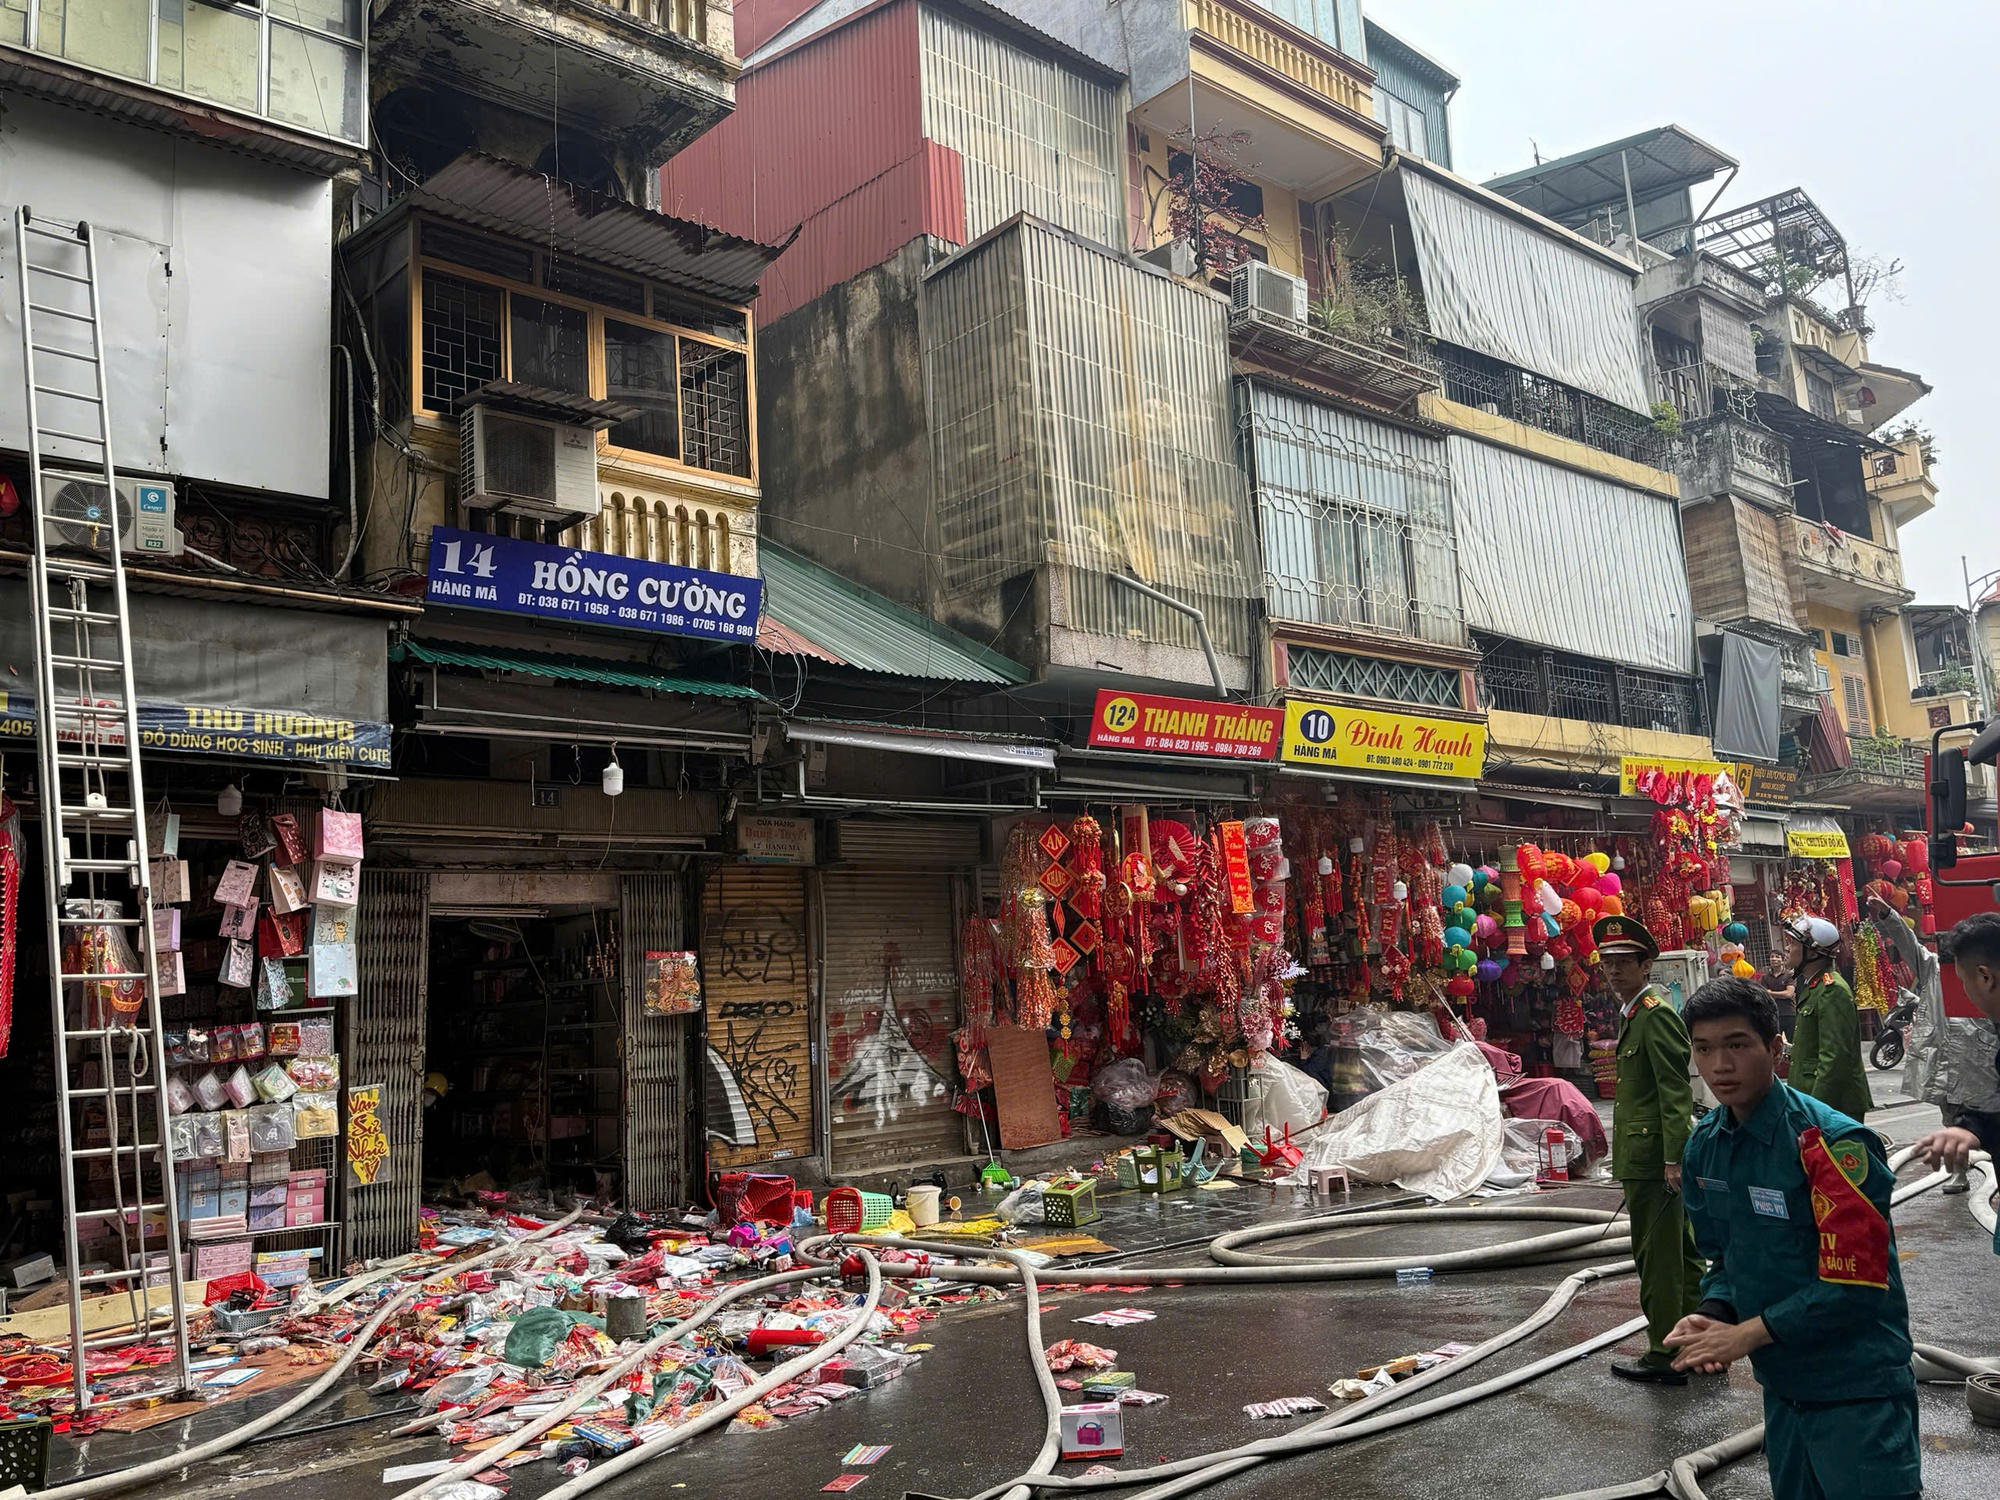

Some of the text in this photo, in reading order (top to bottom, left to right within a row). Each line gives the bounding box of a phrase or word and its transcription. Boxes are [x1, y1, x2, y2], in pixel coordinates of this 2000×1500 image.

[147, 540, 162, 548] R32
[438, 540, 498, 579] 14
[431, 578, 498, 601] HÀNG MÃ
[531, 551, 747, 619] HỒNG CƯỜNG
[518, 592, 536, 606] ĐT:
[538, 595, 559, 609] 038
[561, 598, 580, 612] 671
[584, 602, 609, 616] 1958
[618, 606, 637, 620] 038
[640, 610, 657, 623] 671
[661, 612, 684, 627] 1986
[692, 617, 716, 631] 0705
[718, 621, 734, 635] 168
[736, 623, 753, 637] 980
[184, 707, 243, 731] THU
[1143, 707, 1274, 744] THANH THẮNG
[1307, 714, 1330, 740] 10
[143, 724, 166, 746] ĐỒ
[170, 729, 212, 750] DÙNG
[253, 738, 284, 756] SINH
[1097, 733, 1135, 745] HÀNG MÃ
[1413, 725, 1473, 760] Hạnh
[1293, 743, 1338, 761] HÀNG MÃ
[541, 790, 555, 806] 14
[1046, 833, 1063, 850] AN
